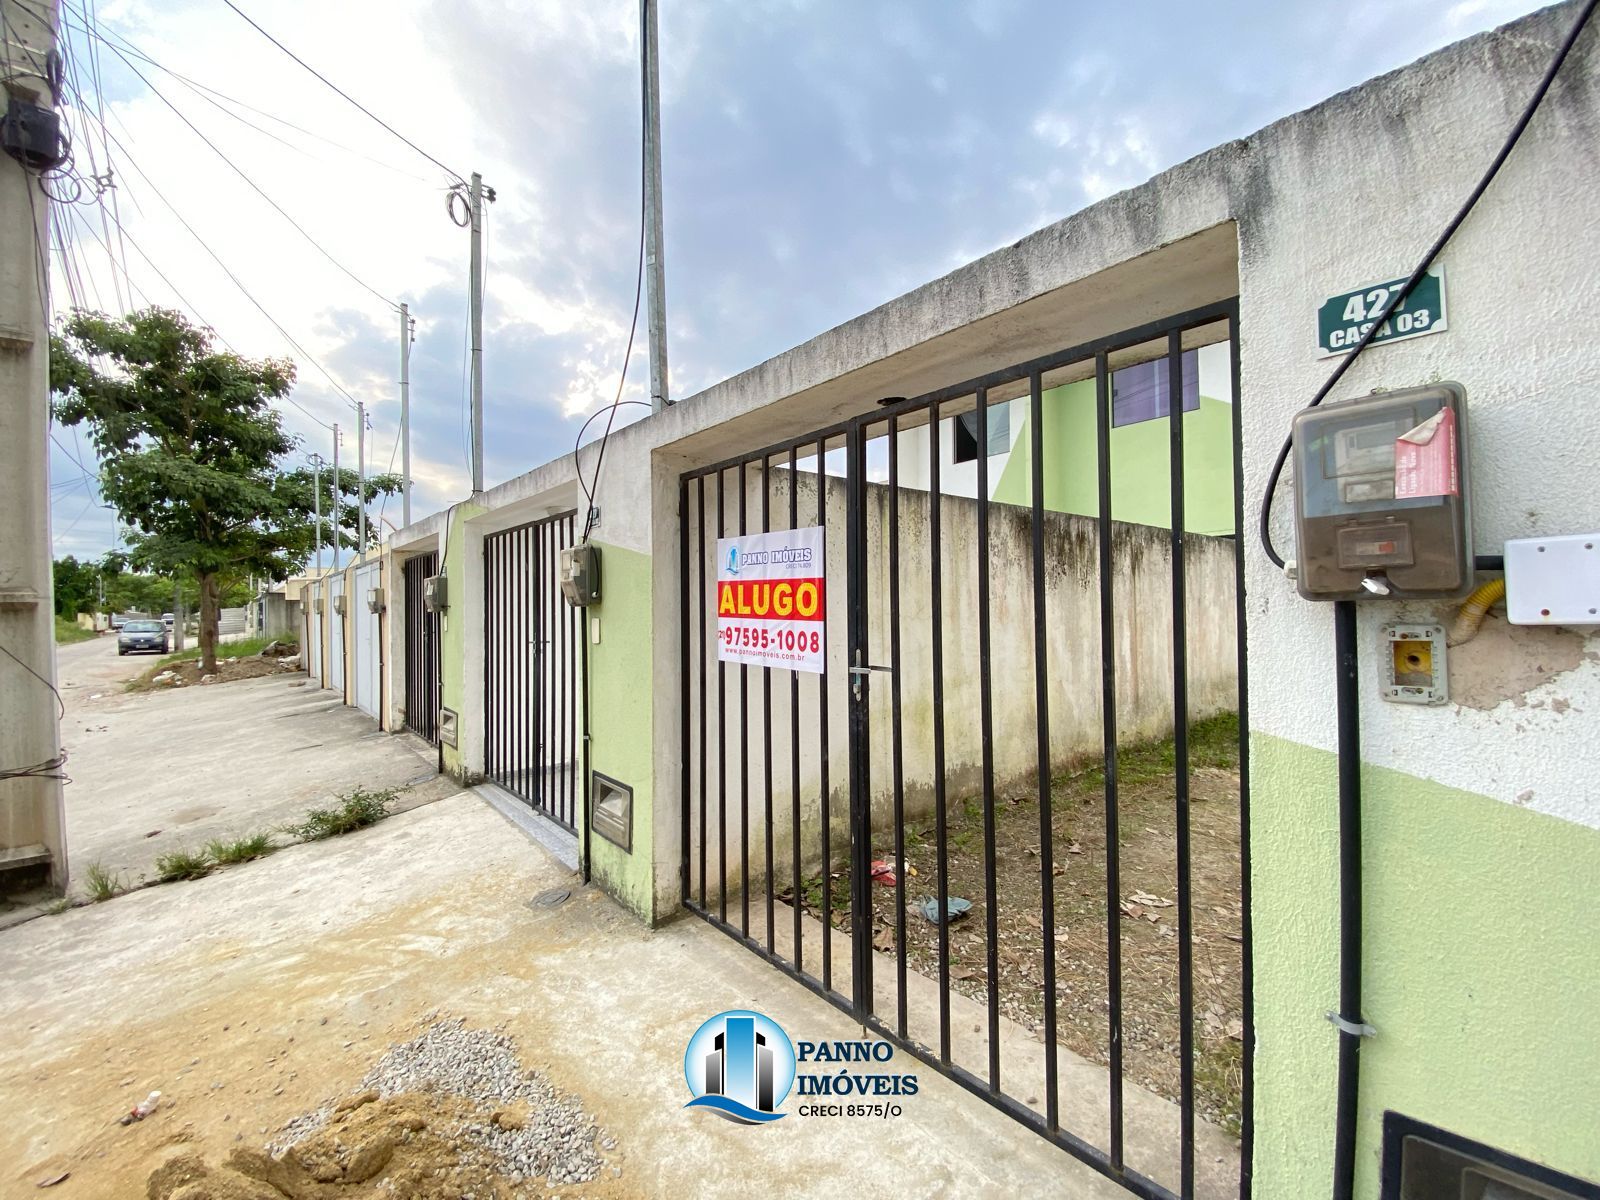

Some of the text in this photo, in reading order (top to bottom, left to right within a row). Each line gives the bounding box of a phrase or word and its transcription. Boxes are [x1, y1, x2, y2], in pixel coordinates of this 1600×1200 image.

[1342, 282, 1407, 323] 427
[1396, 309, 1430, 332] 03
[741, 546, 812, 566] PANNO IMÓVEIS
[719, 582, 818, 617] ALUGO
[725, 626, 820, 653] 97595-1008
